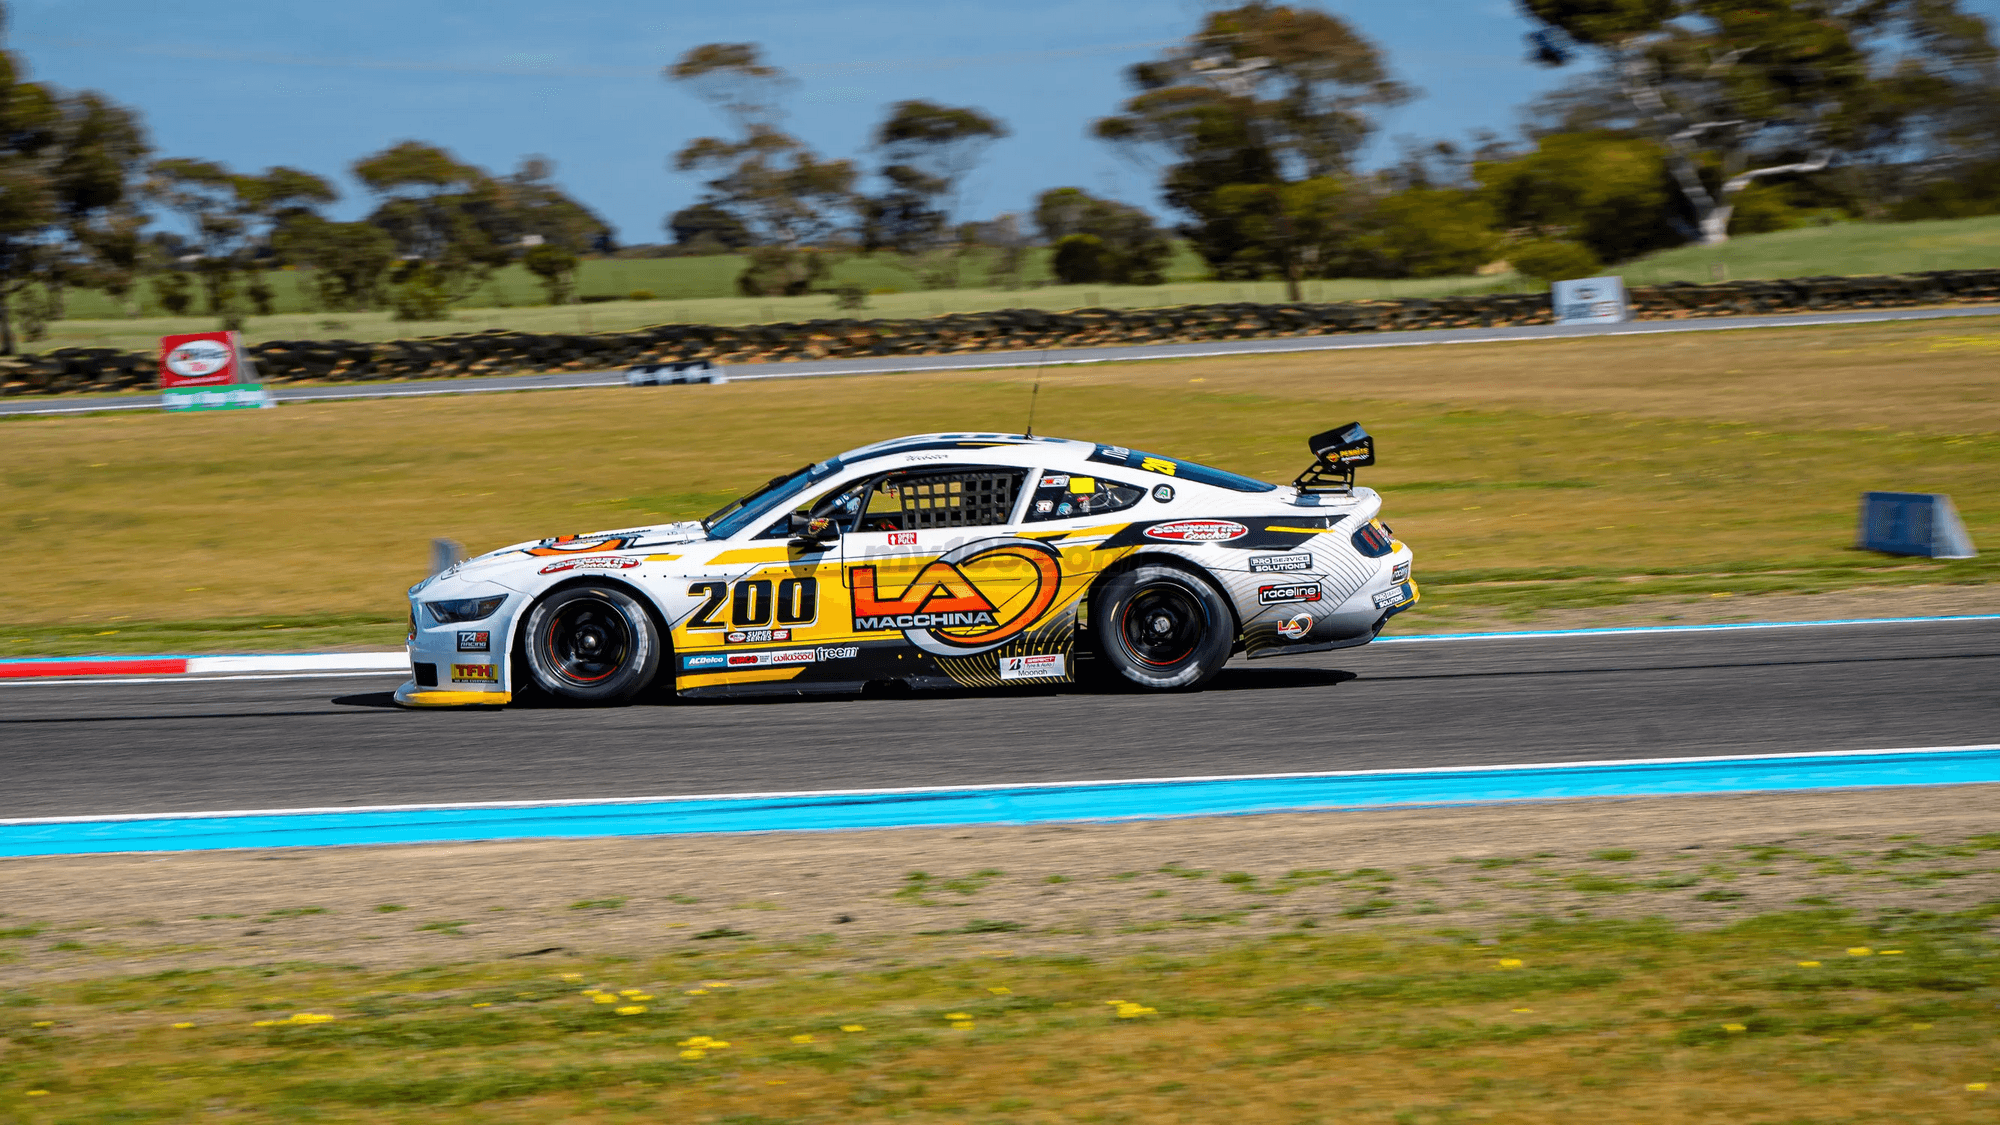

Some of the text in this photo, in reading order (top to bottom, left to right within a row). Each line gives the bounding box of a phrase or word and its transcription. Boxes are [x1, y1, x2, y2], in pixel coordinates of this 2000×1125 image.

[1255, 562, 1307, 572] SOLUTIONS
[852, 560, 1001, 616] LA
[1263, 586, 1317, 599] raceline
[686, 578, 819, 634] 200
[855, 611, 993, 630] MACCHINA
[816, 647, 858, 661] freem
[688, 656, 724, 666] ACDelco
[1018, 668, 1048, 676] Moonah
